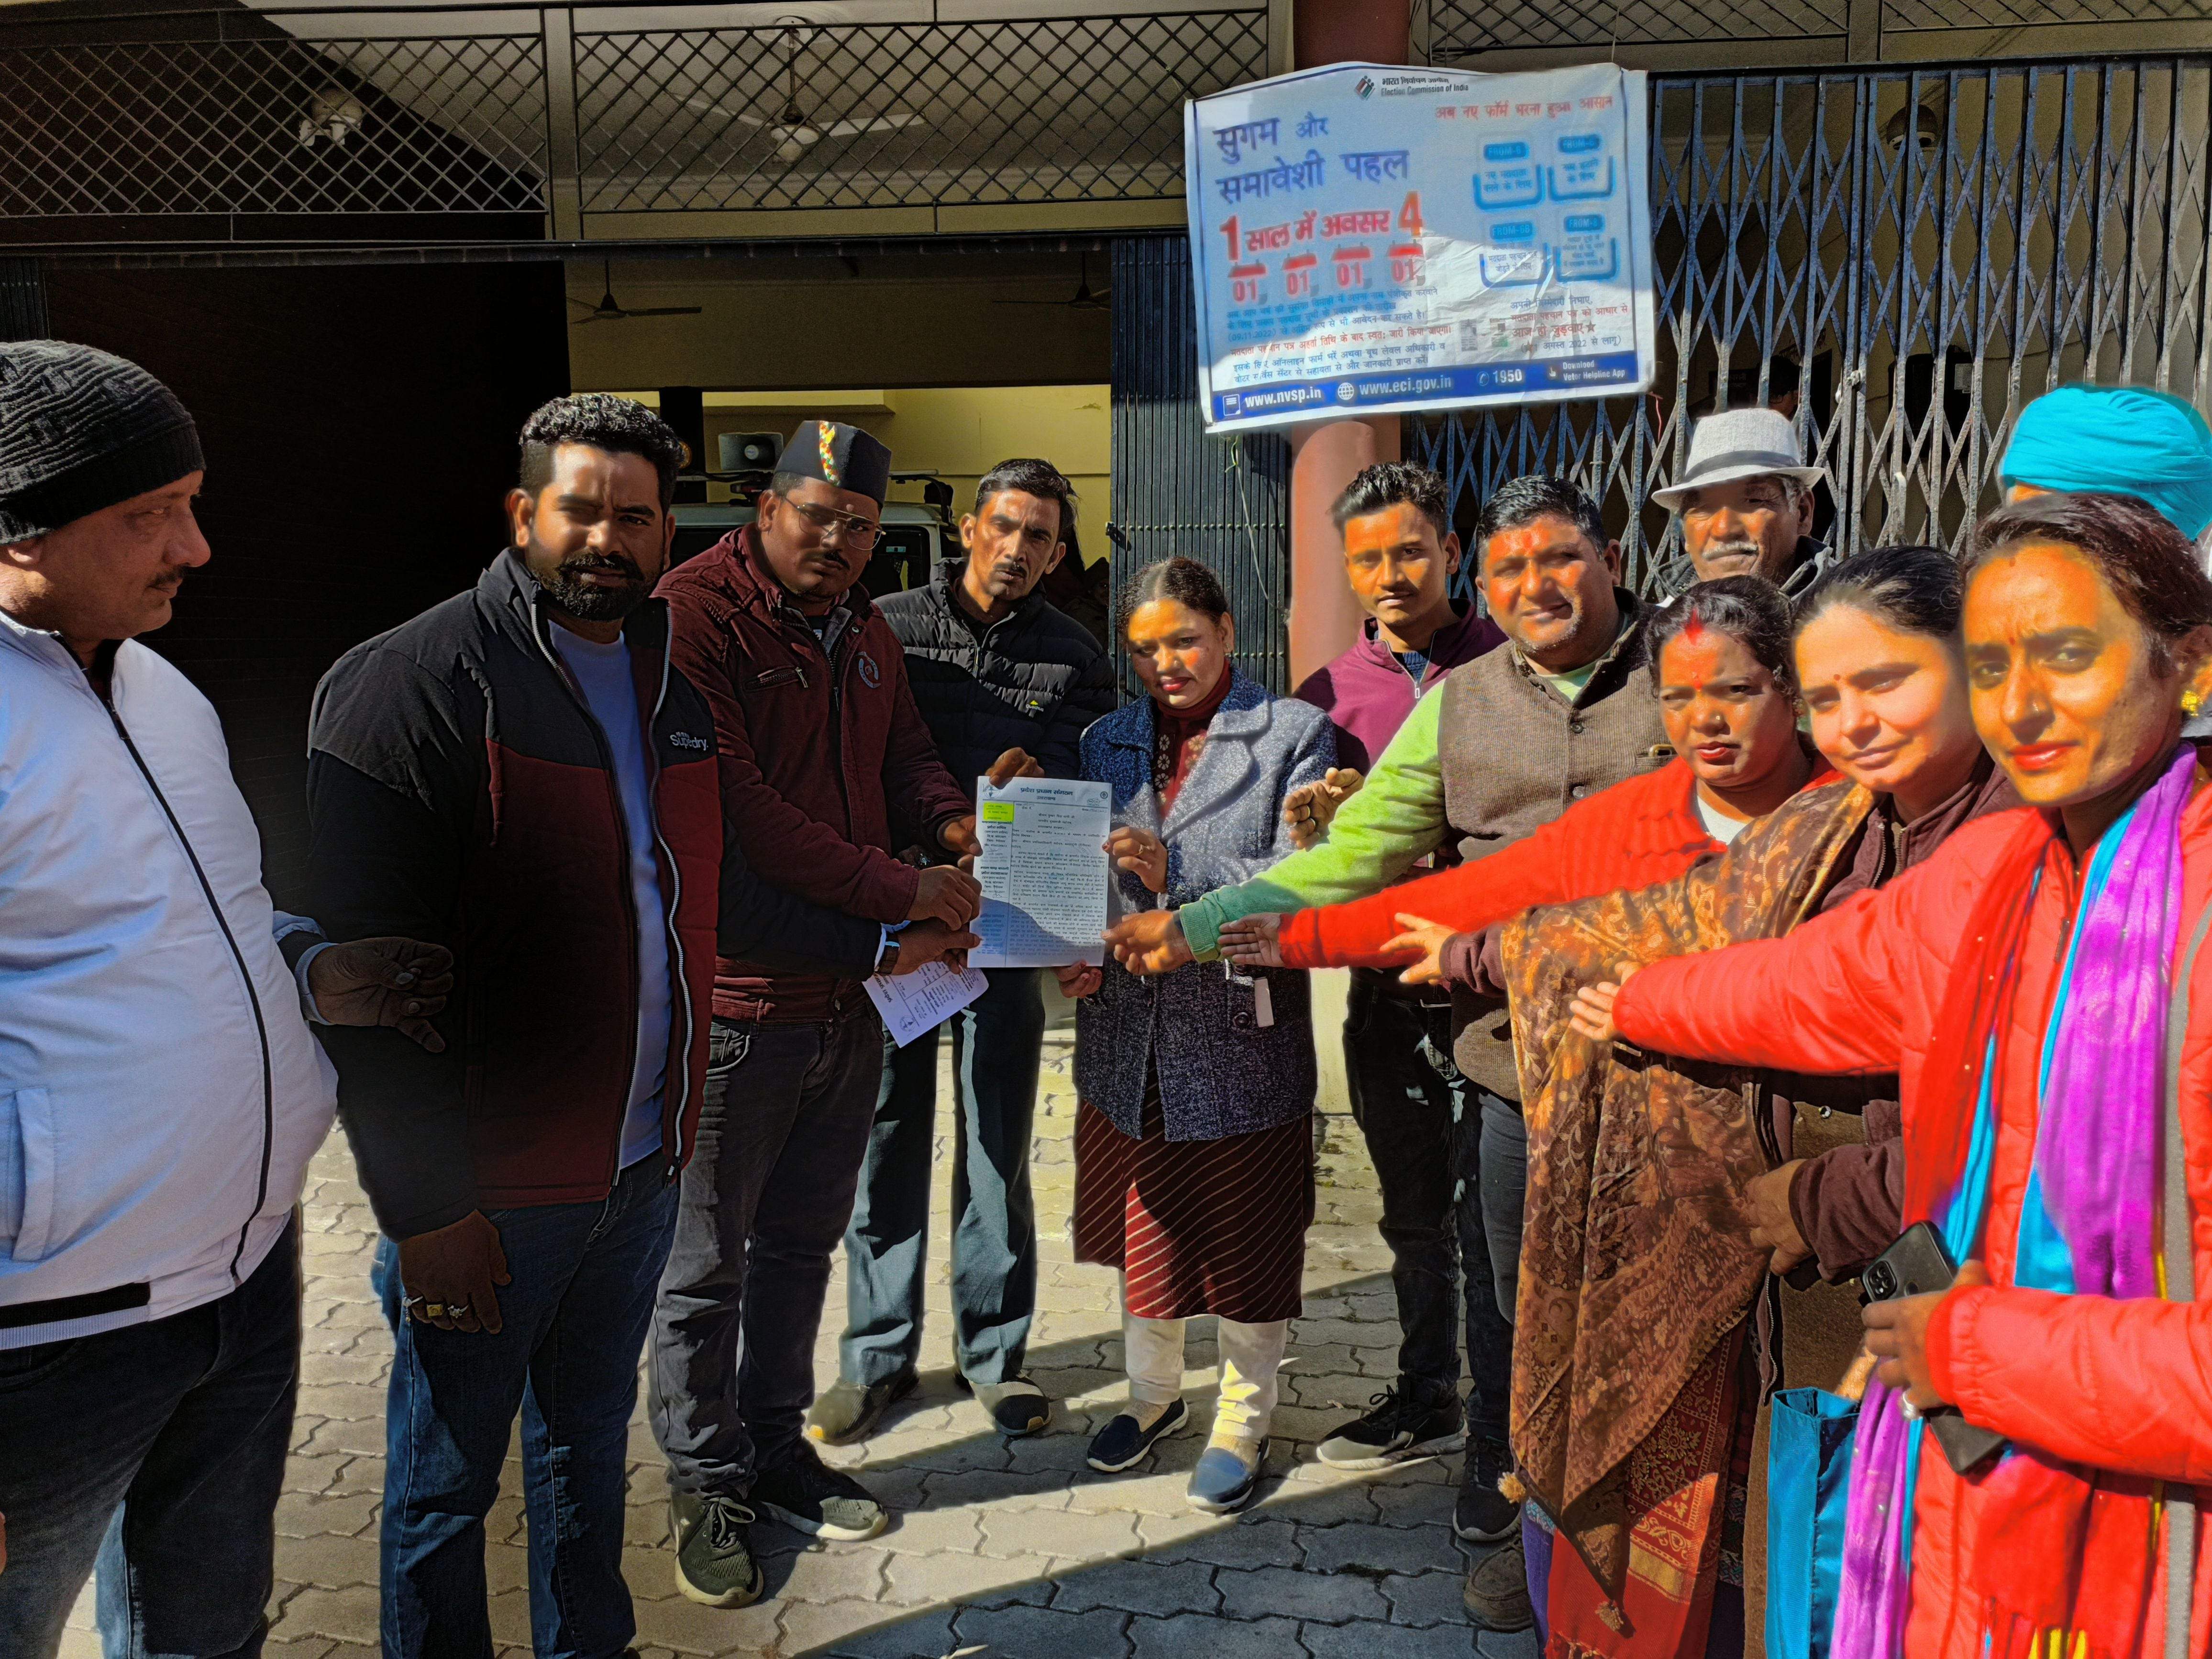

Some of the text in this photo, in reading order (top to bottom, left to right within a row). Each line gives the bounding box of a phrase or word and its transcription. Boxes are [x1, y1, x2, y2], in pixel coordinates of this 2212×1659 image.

[1381, 83, 1469, 96] Election Commission of India
[1436, 96, 1613, 119] अब नए फॉर्म भरना हुआ आसान
[1213, 111, 1329, 164] सुगम और
[1215, 149, 1410, 204] समावेशी पहल
[1219, 190, 1424, 261] 1 साल में अवसर 4
[1488, 254, 1507, 263] मतदाता
[1232, 259, 1415, 302] 01 01 01 01
[1348, 292, 1367, 302] अपना
[1370, 291, 1384, 299] नाम
[1387, 288, 1412, 300] पंजीकृत
[1415, 286, 1438, 297] करवाने
[1510, 299, 1531, 310] अपनी
[1511, 312, 1536, 322] मतदाता
[1540, 310, 1563, 320] पहचान
[1582, 306, 1592, 317] को
[1596, 306, 1617, 315] आधार
[1621, 303, 1628, 313] से
[1228, 328, 1276, 342] (09.11.2022)
[1328, 318, 1336, 328] से
[1339, 315, 1348, 326] भी
[1352, 314, 1377, 324] आवेदन
[1381, 314, 1392, 322] कर
[1395, 311, 1413, 321] सकते
[1512, 326, 1533, 338] आज
[1537, 324, 1548, 336] ही
[1230, 346, 1254, 356] मतदाता
[1284, 342, 1295, 350] पत्र
[1320, 334, 1336, 346] तिथि
[1339, 332, 1348, 343] के
[1351, 332, 1364, 342] बाद
[1389, 326, 1403, 338] जारी
[1407, 326, 1424, 336] किया
[1543, 341, 1565, 350] अगस्त
[1592, 336, 1599, 346] से
[1233, 361, 1250, 372] इसके
[1272, 356, 1305, 367] ऑनलाइन
[1308, 352, 1323, 364] फार्म
[1327, 350, 1338, 360] भरें
[1340, 350, 1362, 358] अथवा
[1366, 348, 1378, 359] बूथ
[1382, 345, 1401, 354] लेवल
[1405, 343, 1435, 353] अधिकारी
[1234, 373, 1250, 384] वोटर
[1277, 367, 1292, 377] सेंटर
[1295, 366, 1303, 376] से
[1306, 365, 1332, 376] सहायता
[1347, 359, 1360, 370] और
[1363, 357, 1392, 368] जानकारी
[1396, 358, 1412, 367] प्राप्त
[1493, 369, 1522, 383] 1950
[1583, 369, 1610, 380] Helpline
[1612, 369, 1625, 379] App
[1359, 375, 1451, 395] www.eci.gov.in
[1245, 387, 1321, 408] www.nvsp.in
[1053, 788, 1073, 796] संगठन
